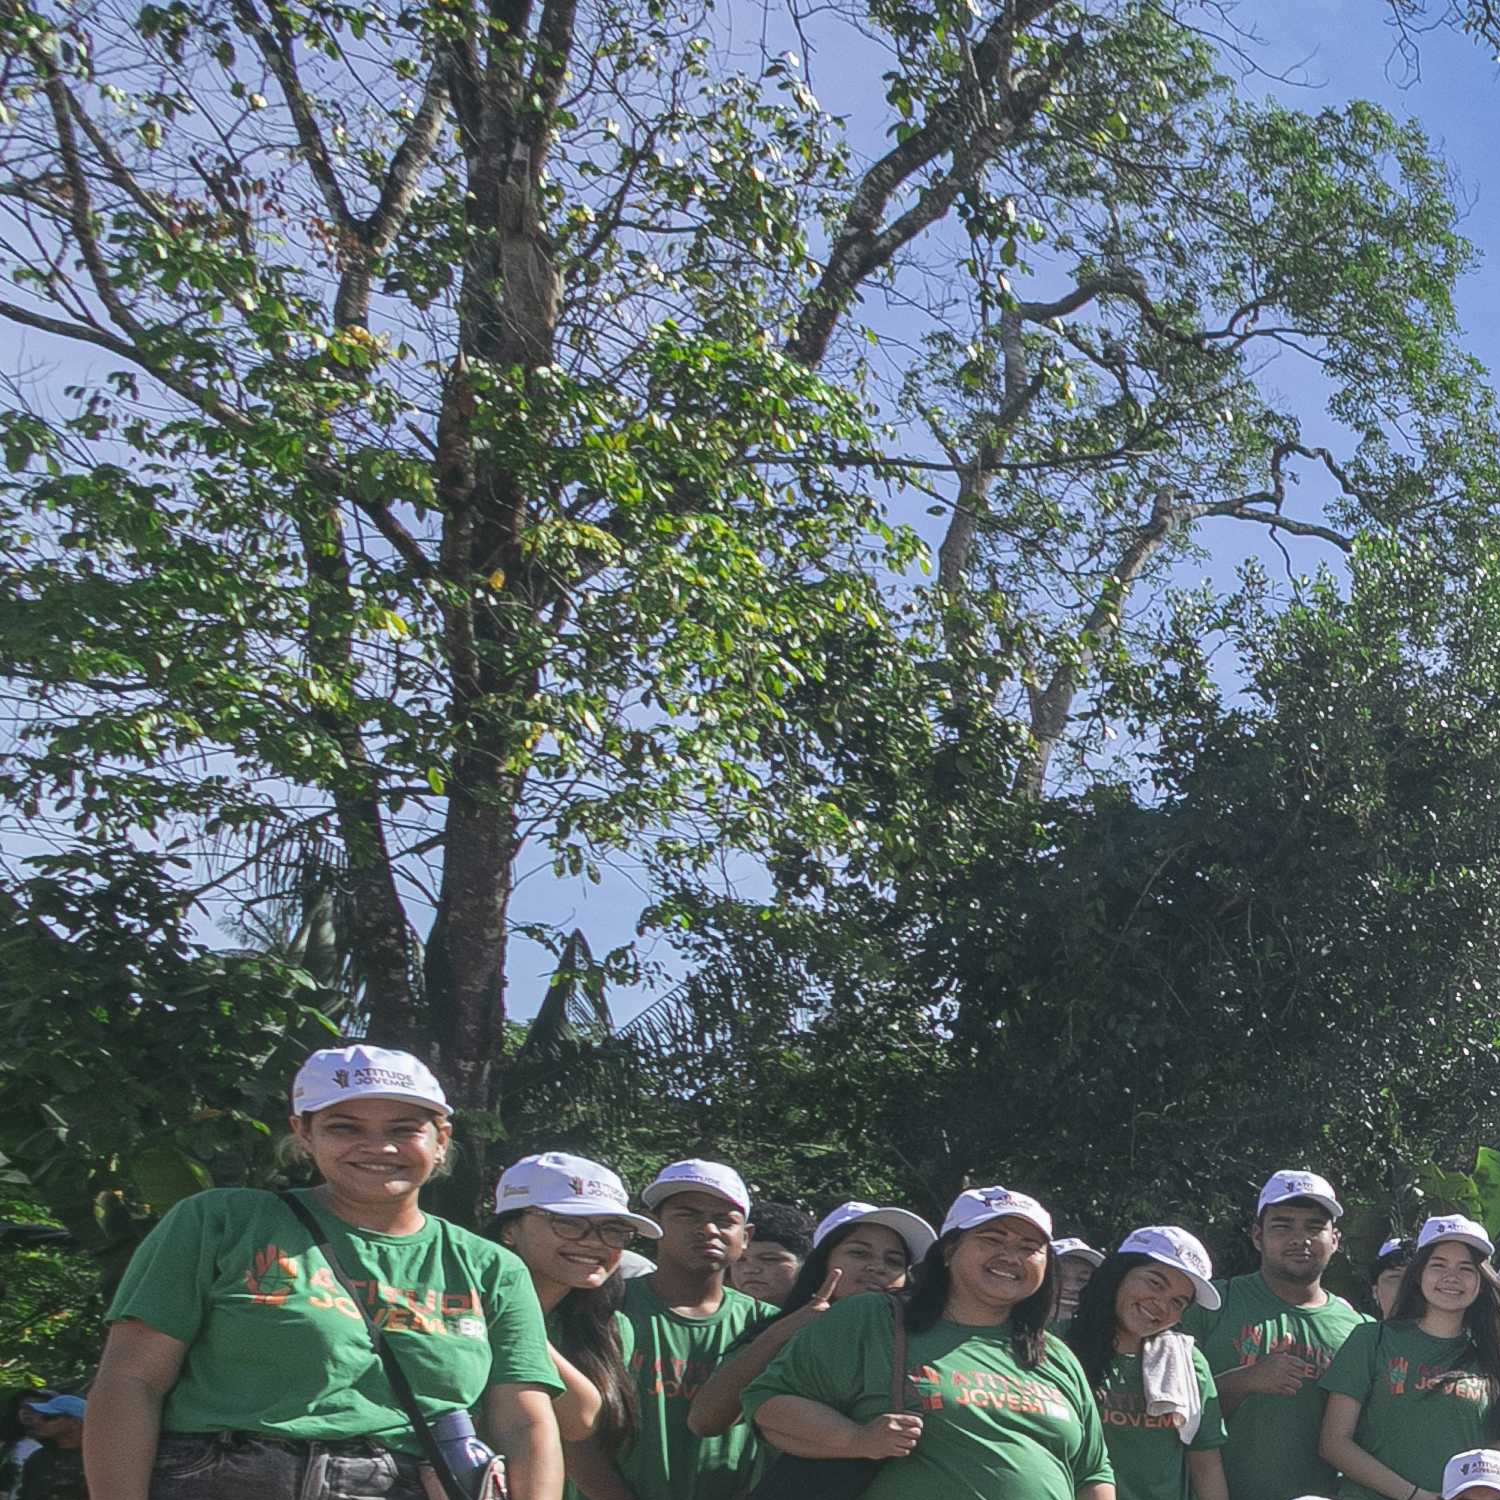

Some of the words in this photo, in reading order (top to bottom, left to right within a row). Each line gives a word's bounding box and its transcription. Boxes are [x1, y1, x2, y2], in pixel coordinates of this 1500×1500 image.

[353, 1067, 413, 1083] ATITUDE
[355, 1076, 401, 1089] JOVEM
[954, 1389, 1047, 1415] JOVEM
